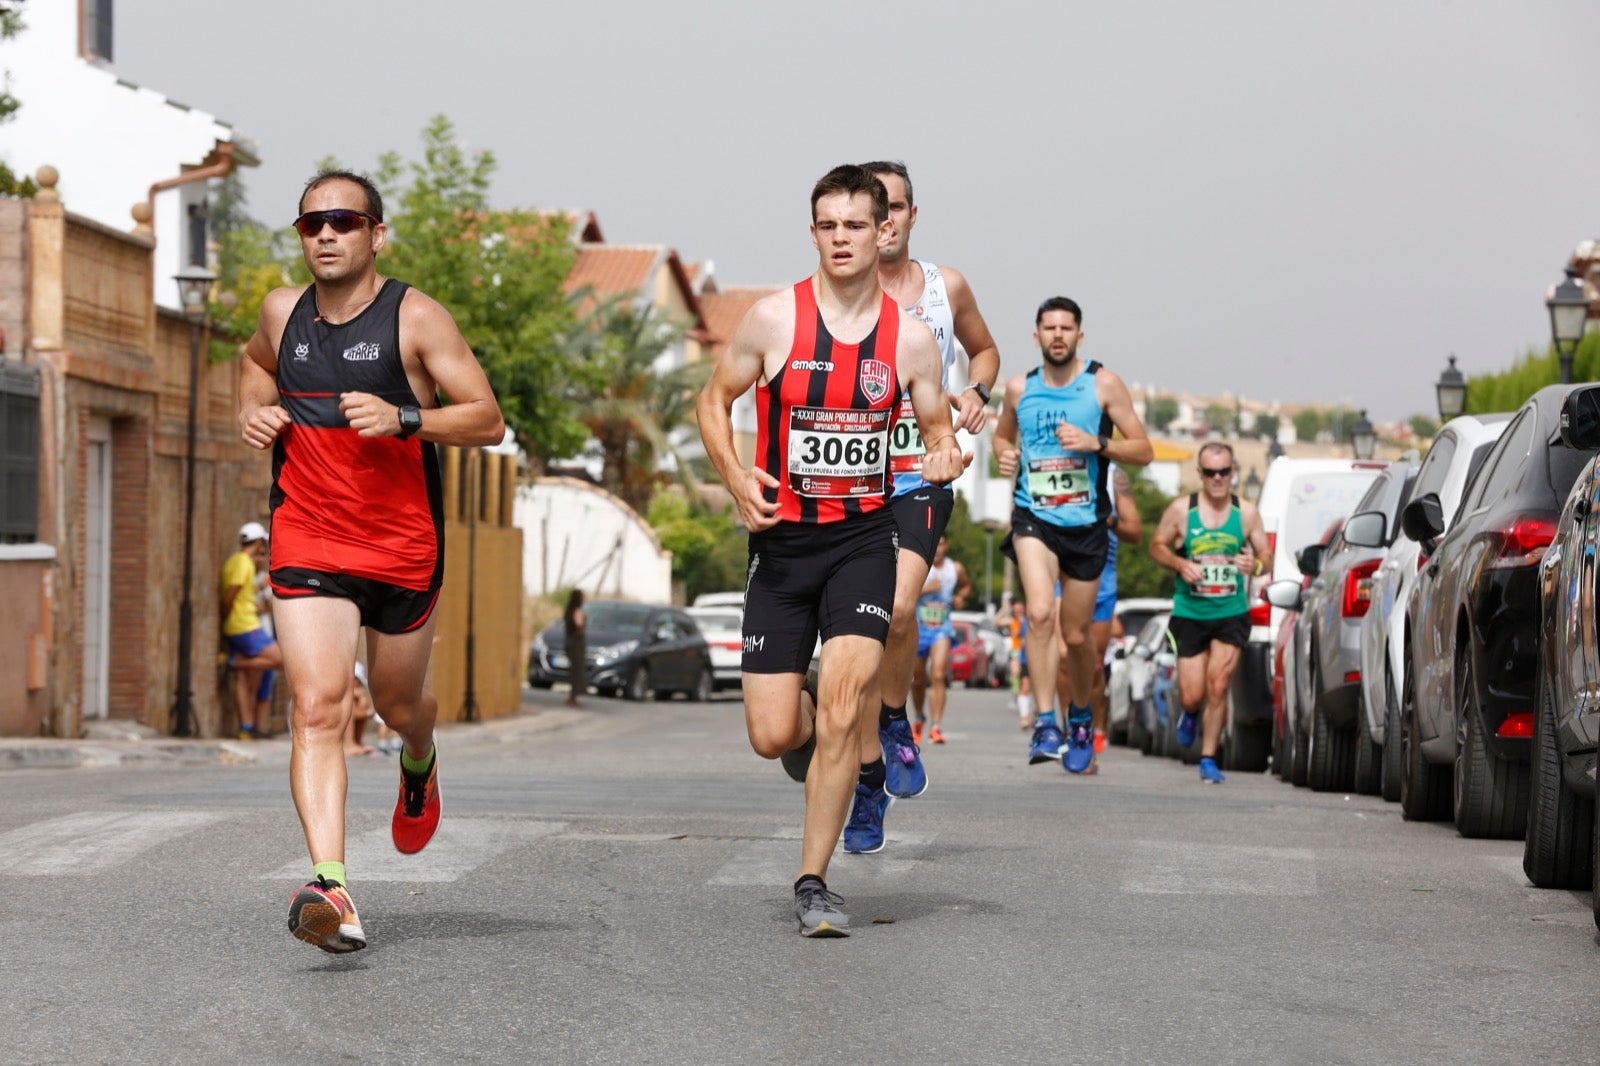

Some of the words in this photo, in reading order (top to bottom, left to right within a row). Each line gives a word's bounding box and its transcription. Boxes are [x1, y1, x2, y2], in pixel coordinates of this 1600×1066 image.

[862, 361, 889, 379] CAIM
[797, 410, 815, 421] XXXII
[816, 411, 832, 422] GRAN
[834, 411, 858, 423] PREMIO
[859, 413, 868, 423] DE
[868, 412, 886, 423] FONDO
[801, 436, 881, 466] 3068
[1048, 473, 1073, 490] 15
[742, 632, 764, 653] AIM
